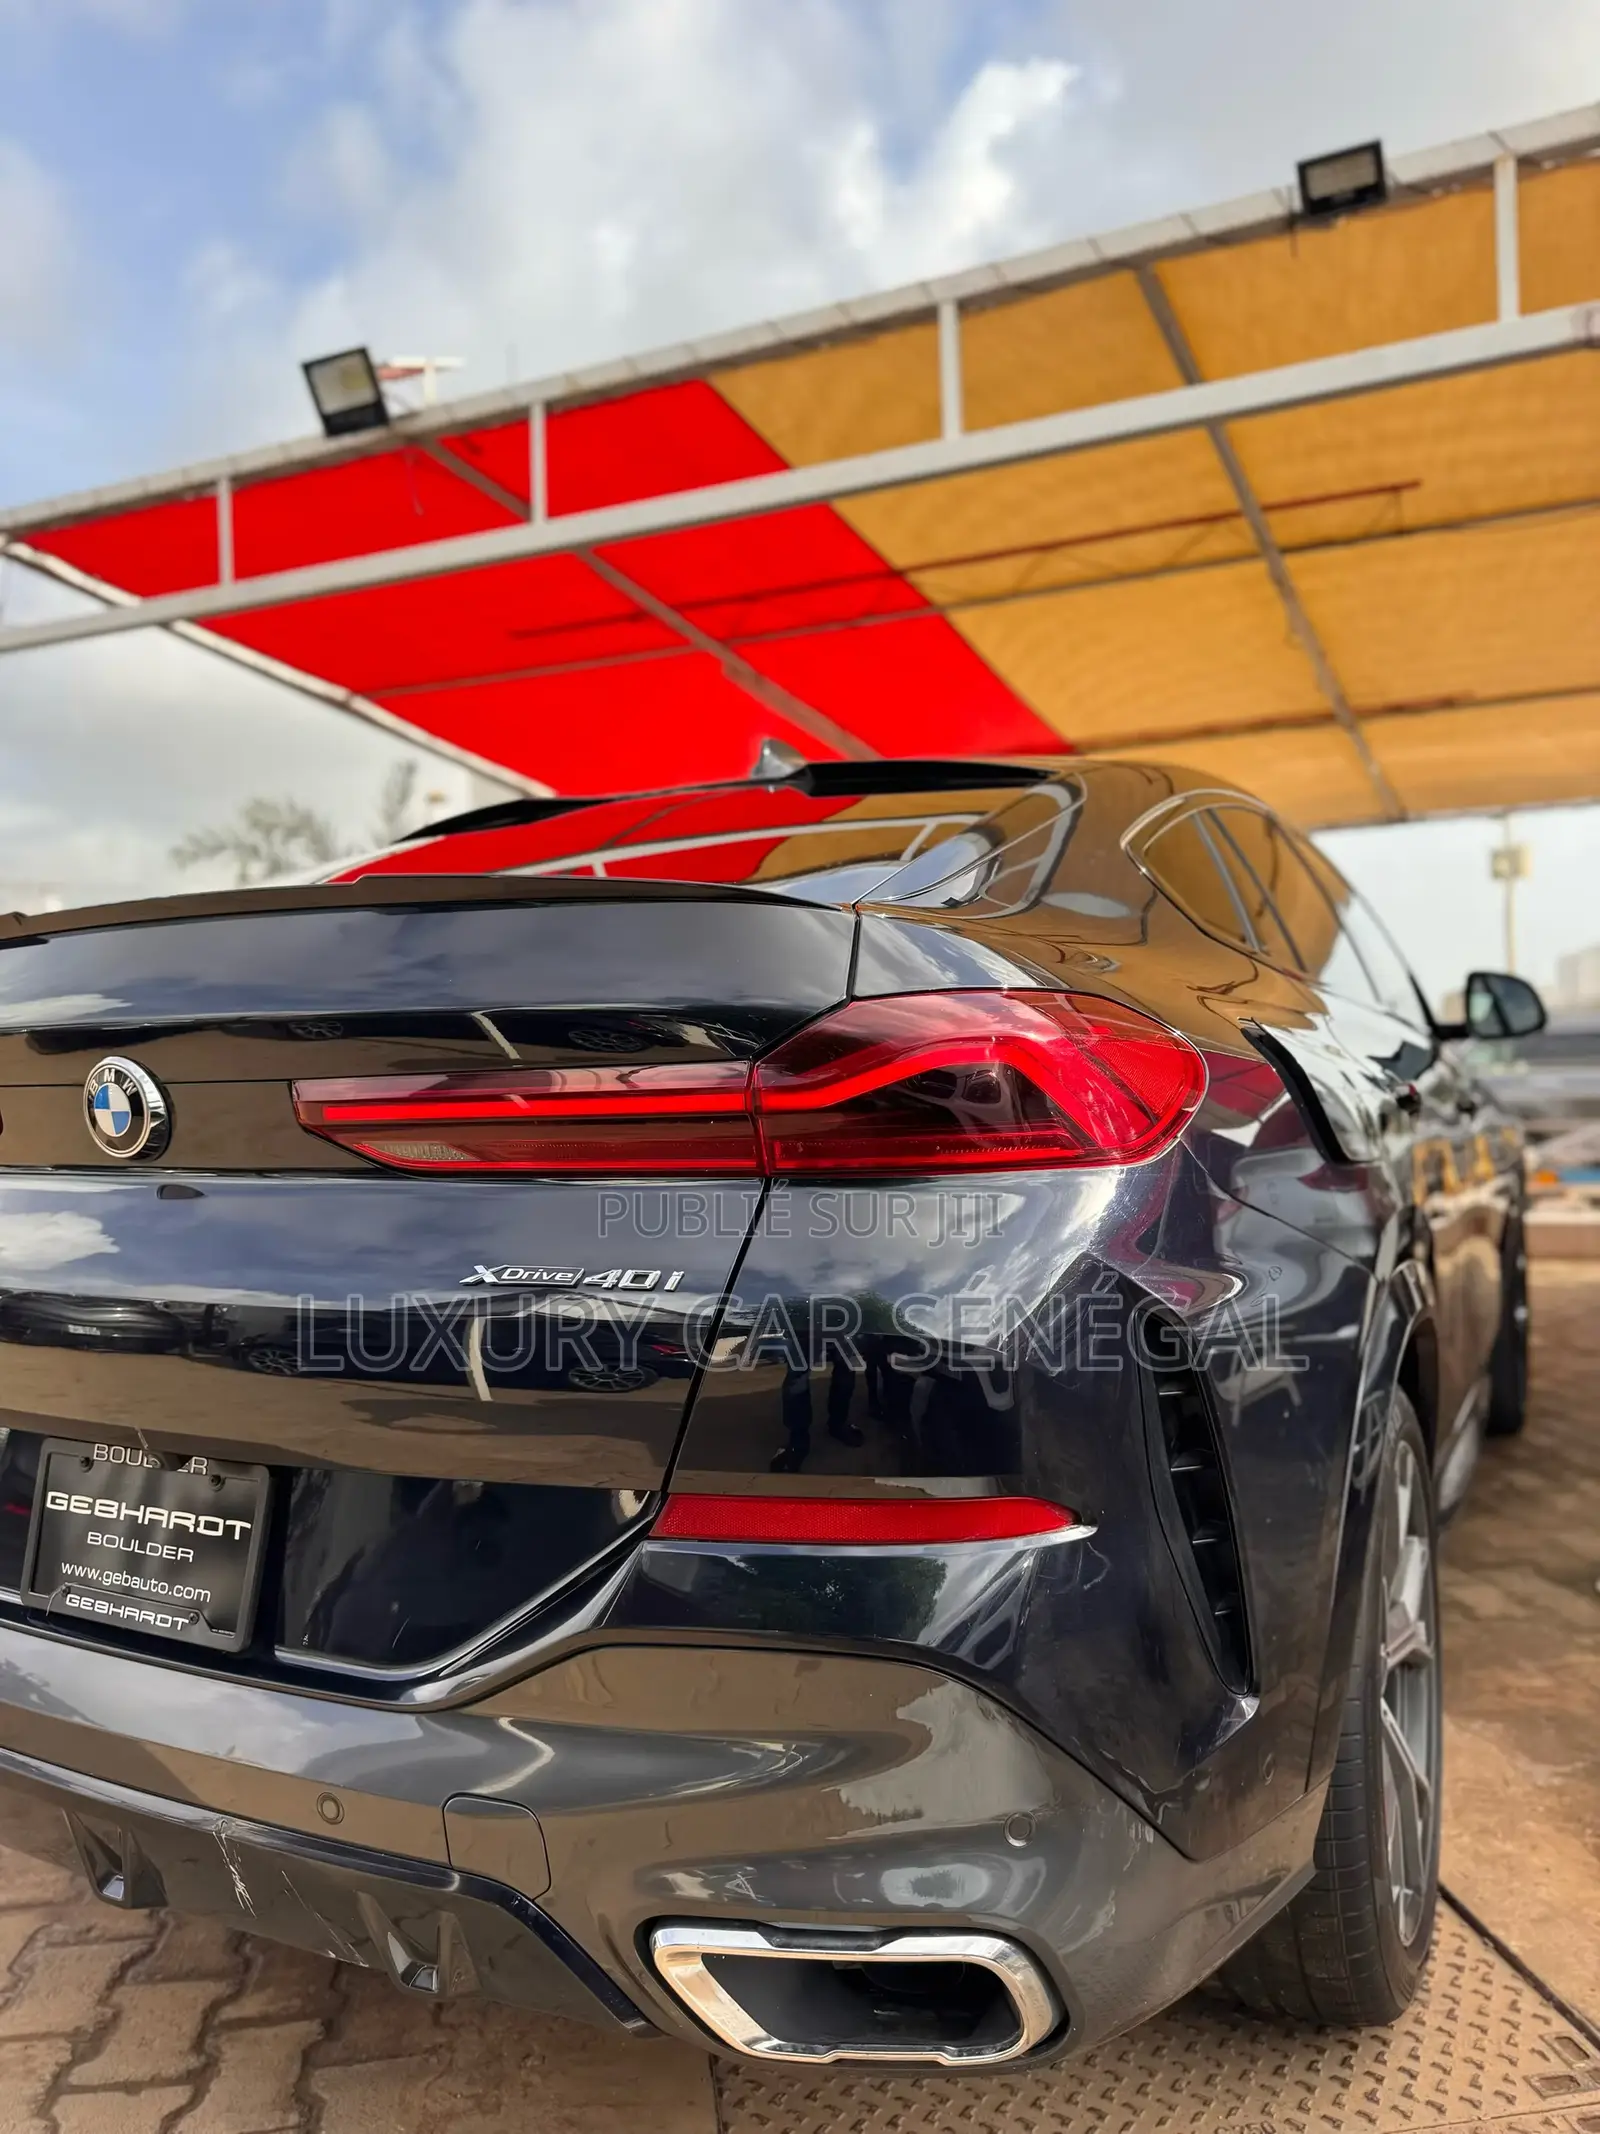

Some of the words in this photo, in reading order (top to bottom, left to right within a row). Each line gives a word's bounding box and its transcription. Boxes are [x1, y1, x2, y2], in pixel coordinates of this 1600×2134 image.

[90, 1068, 137, 1096] BMW
[93, 1443, 208, 1475] BOULR
[46, 1491, 251, 1540] GEBHARDT
[87, 1532, 194, 1562] BOULDER
[61, 1562, 211, 1602] www.gebauto.com
[66, 1594, 189, 1631] GEBHARDT
